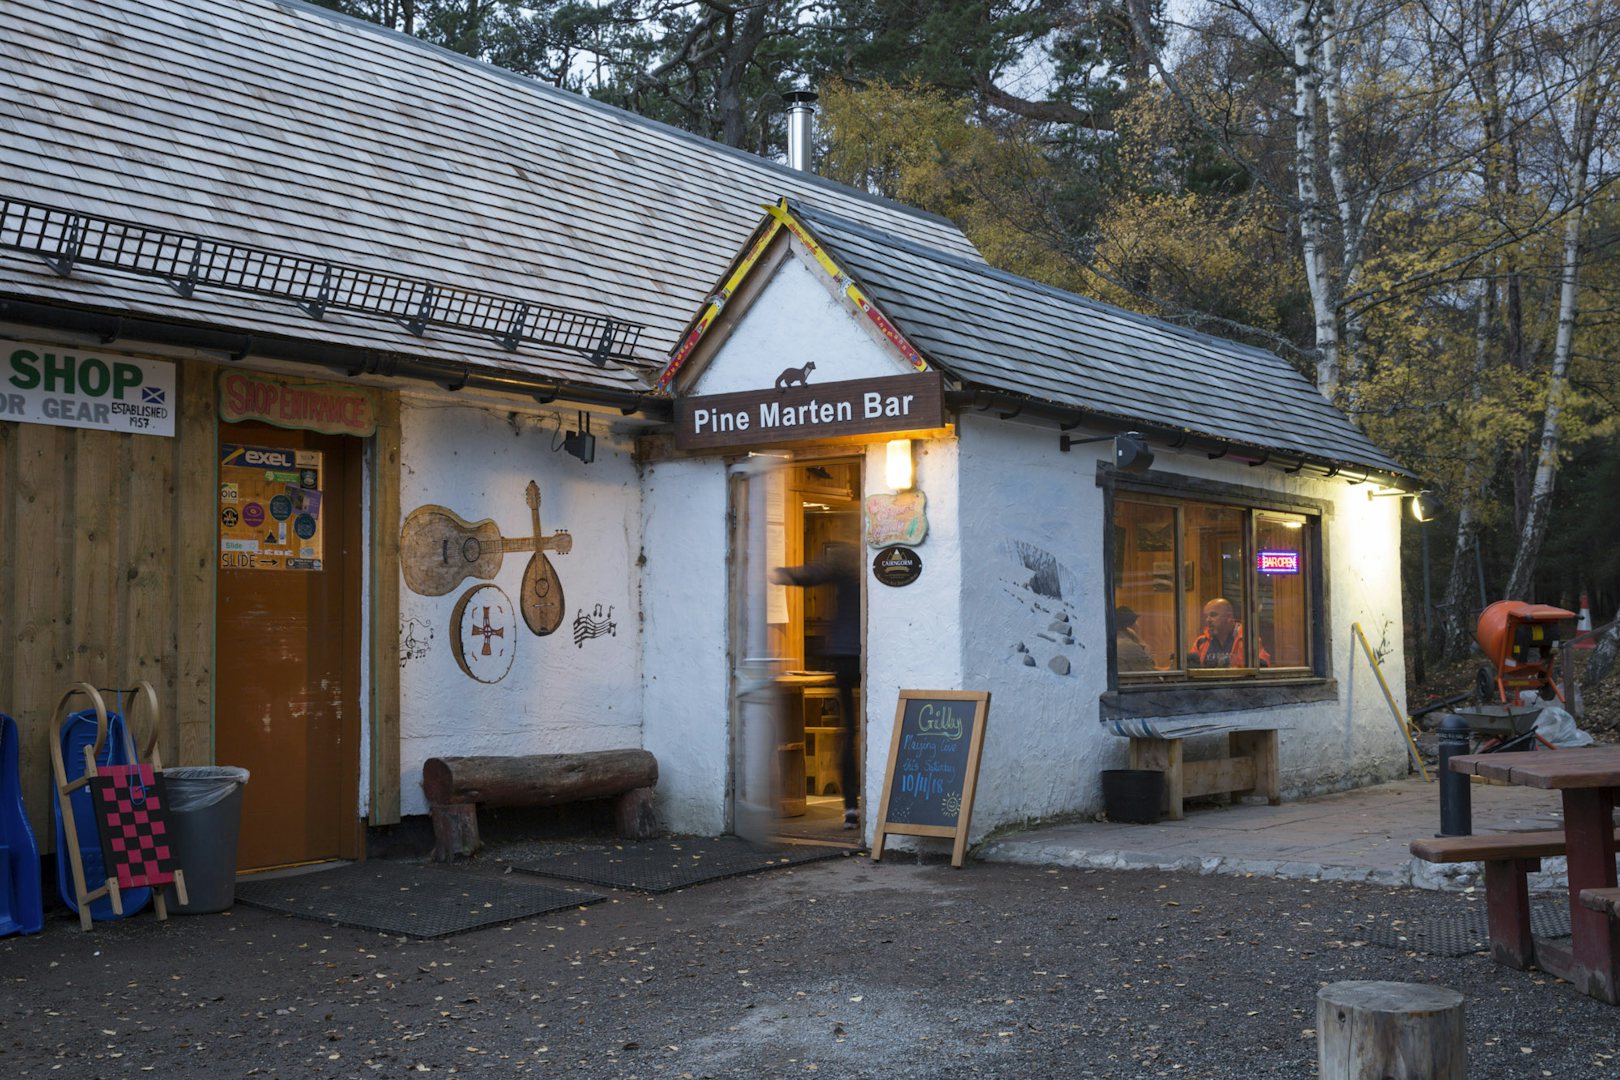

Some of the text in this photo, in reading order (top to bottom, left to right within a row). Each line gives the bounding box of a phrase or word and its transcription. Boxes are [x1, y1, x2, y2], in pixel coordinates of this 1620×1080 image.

[9, 350, 143, 400] SHOP
[42, 398, 110, 424] GEAR
[112, 402, 168, 419] ESTABLISHED
[226, 375, 365, 429] SHOP ENTRANCE
[694, 392, 914, 434] Pine Marten Bar
[130, 417, 150, 429] 1957
[221, 553, 256, 568] SLIDE
[918, 704, 963, 740] Gilly
